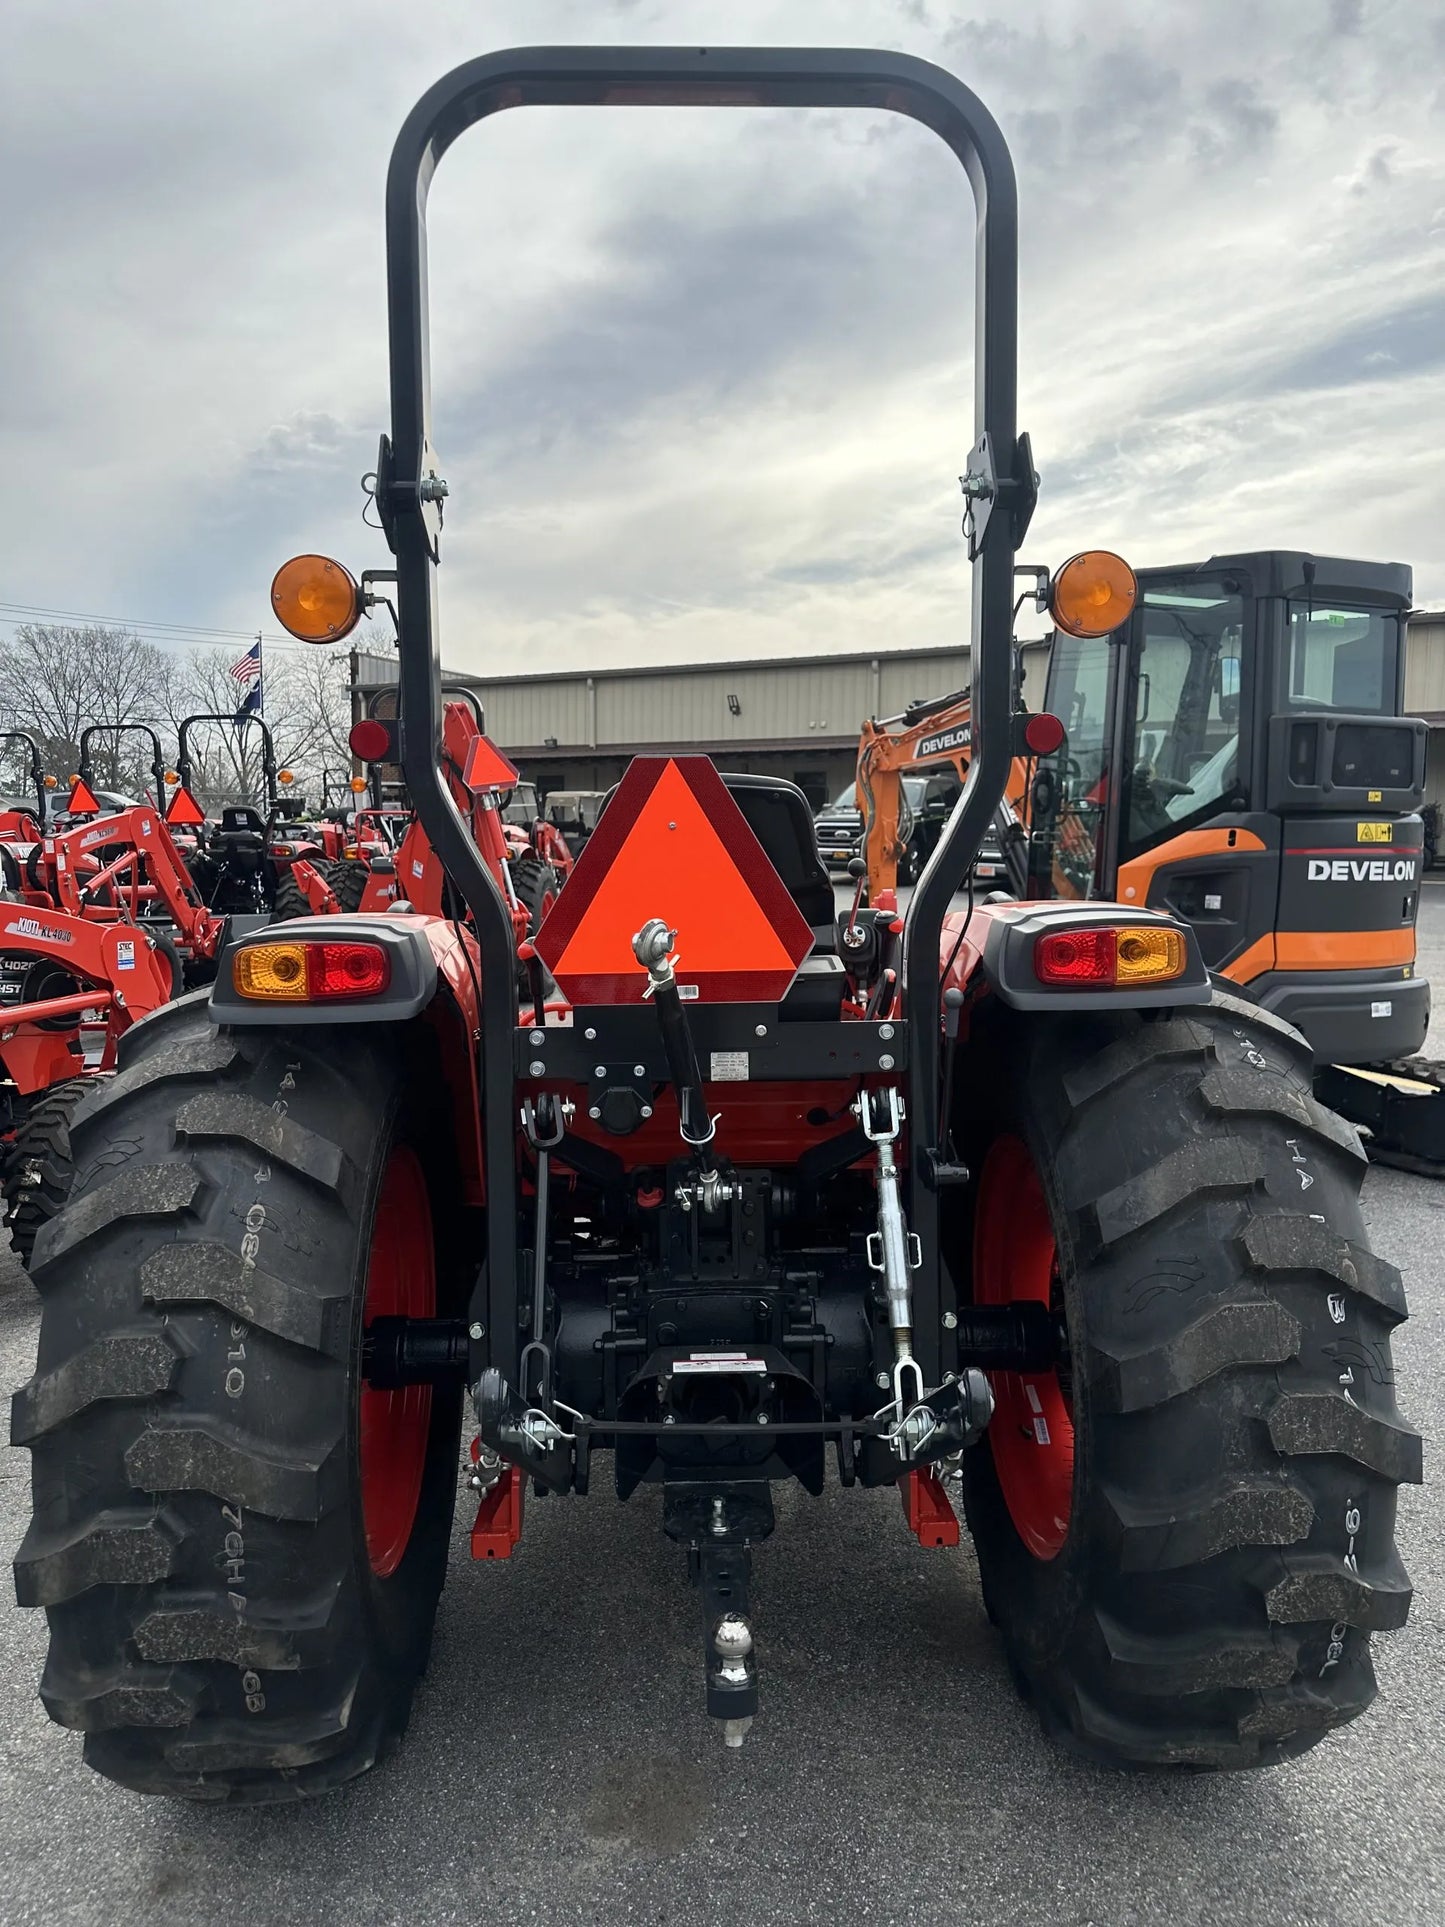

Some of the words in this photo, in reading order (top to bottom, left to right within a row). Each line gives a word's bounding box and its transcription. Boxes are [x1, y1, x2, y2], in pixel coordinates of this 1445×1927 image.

[922, 728, 971, 755] DEVELON
[1308, 859, 1415, 881] DEVELON
[17, 917, 40, 936] KIOTI
